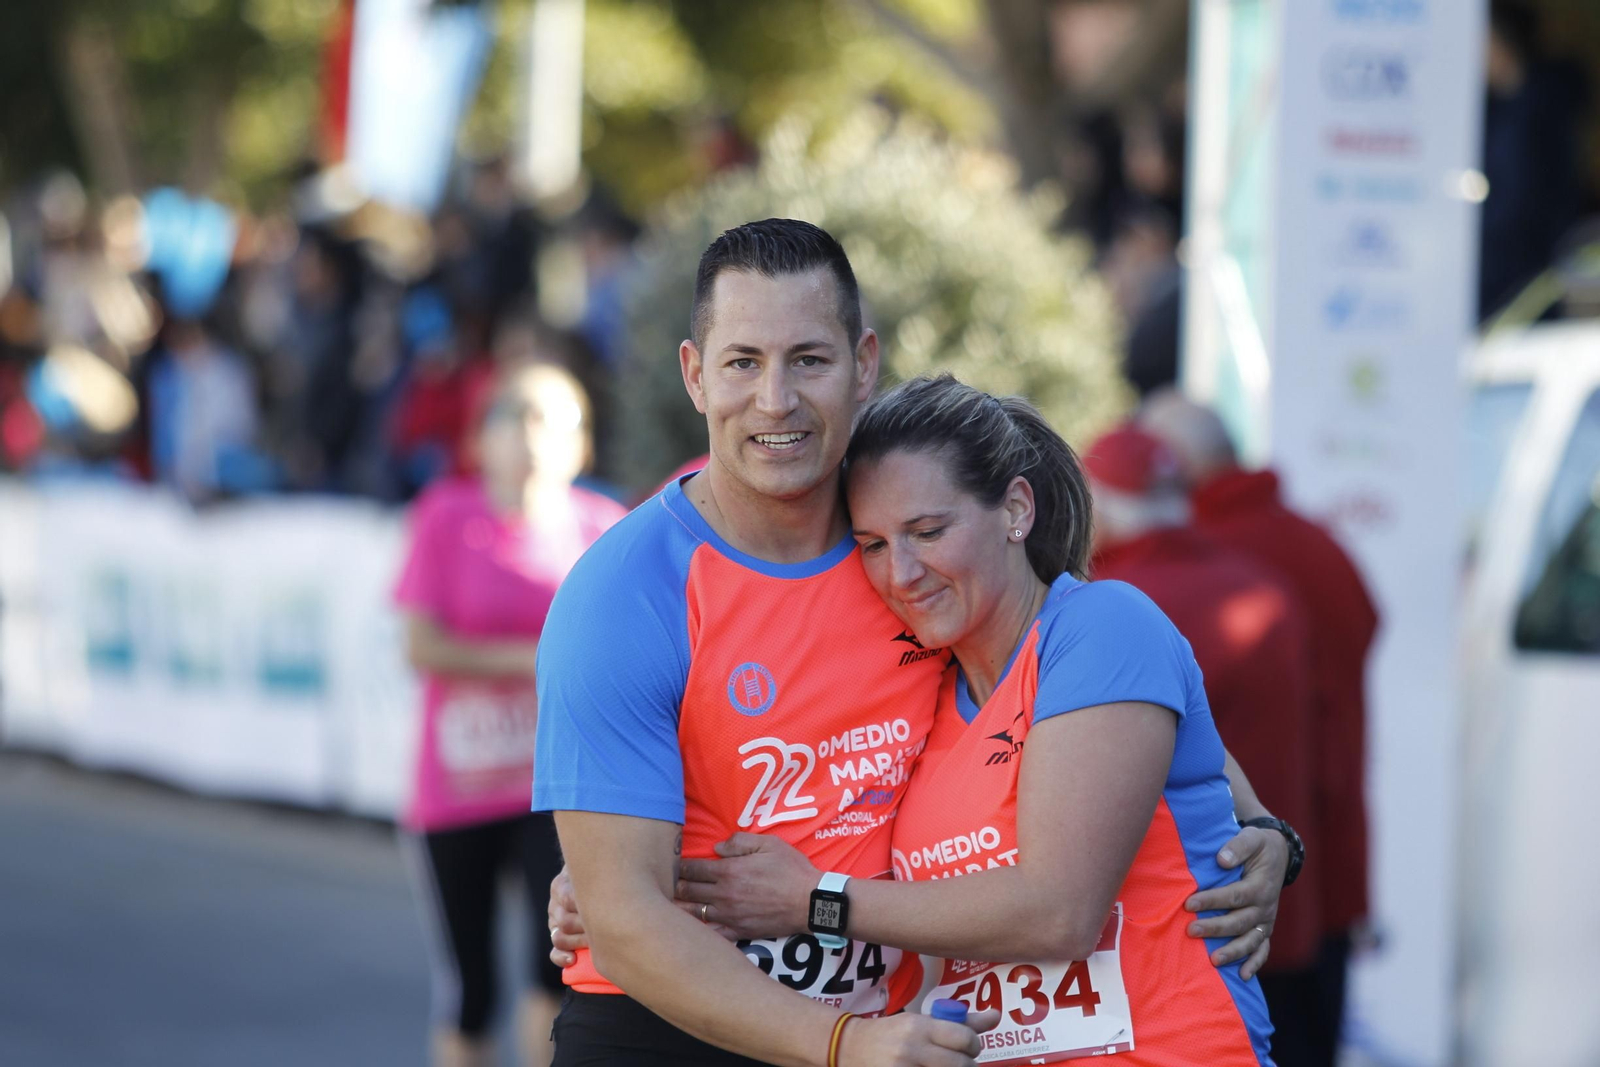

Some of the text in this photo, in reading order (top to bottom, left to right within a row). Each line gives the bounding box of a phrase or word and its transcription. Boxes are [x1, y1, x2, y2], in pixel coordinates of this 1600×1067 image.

[816, 907, 838, 920] 40:43
[736, 933, 887, 995] 5924
[979, 1027, 1047, 1051] JESSICA
